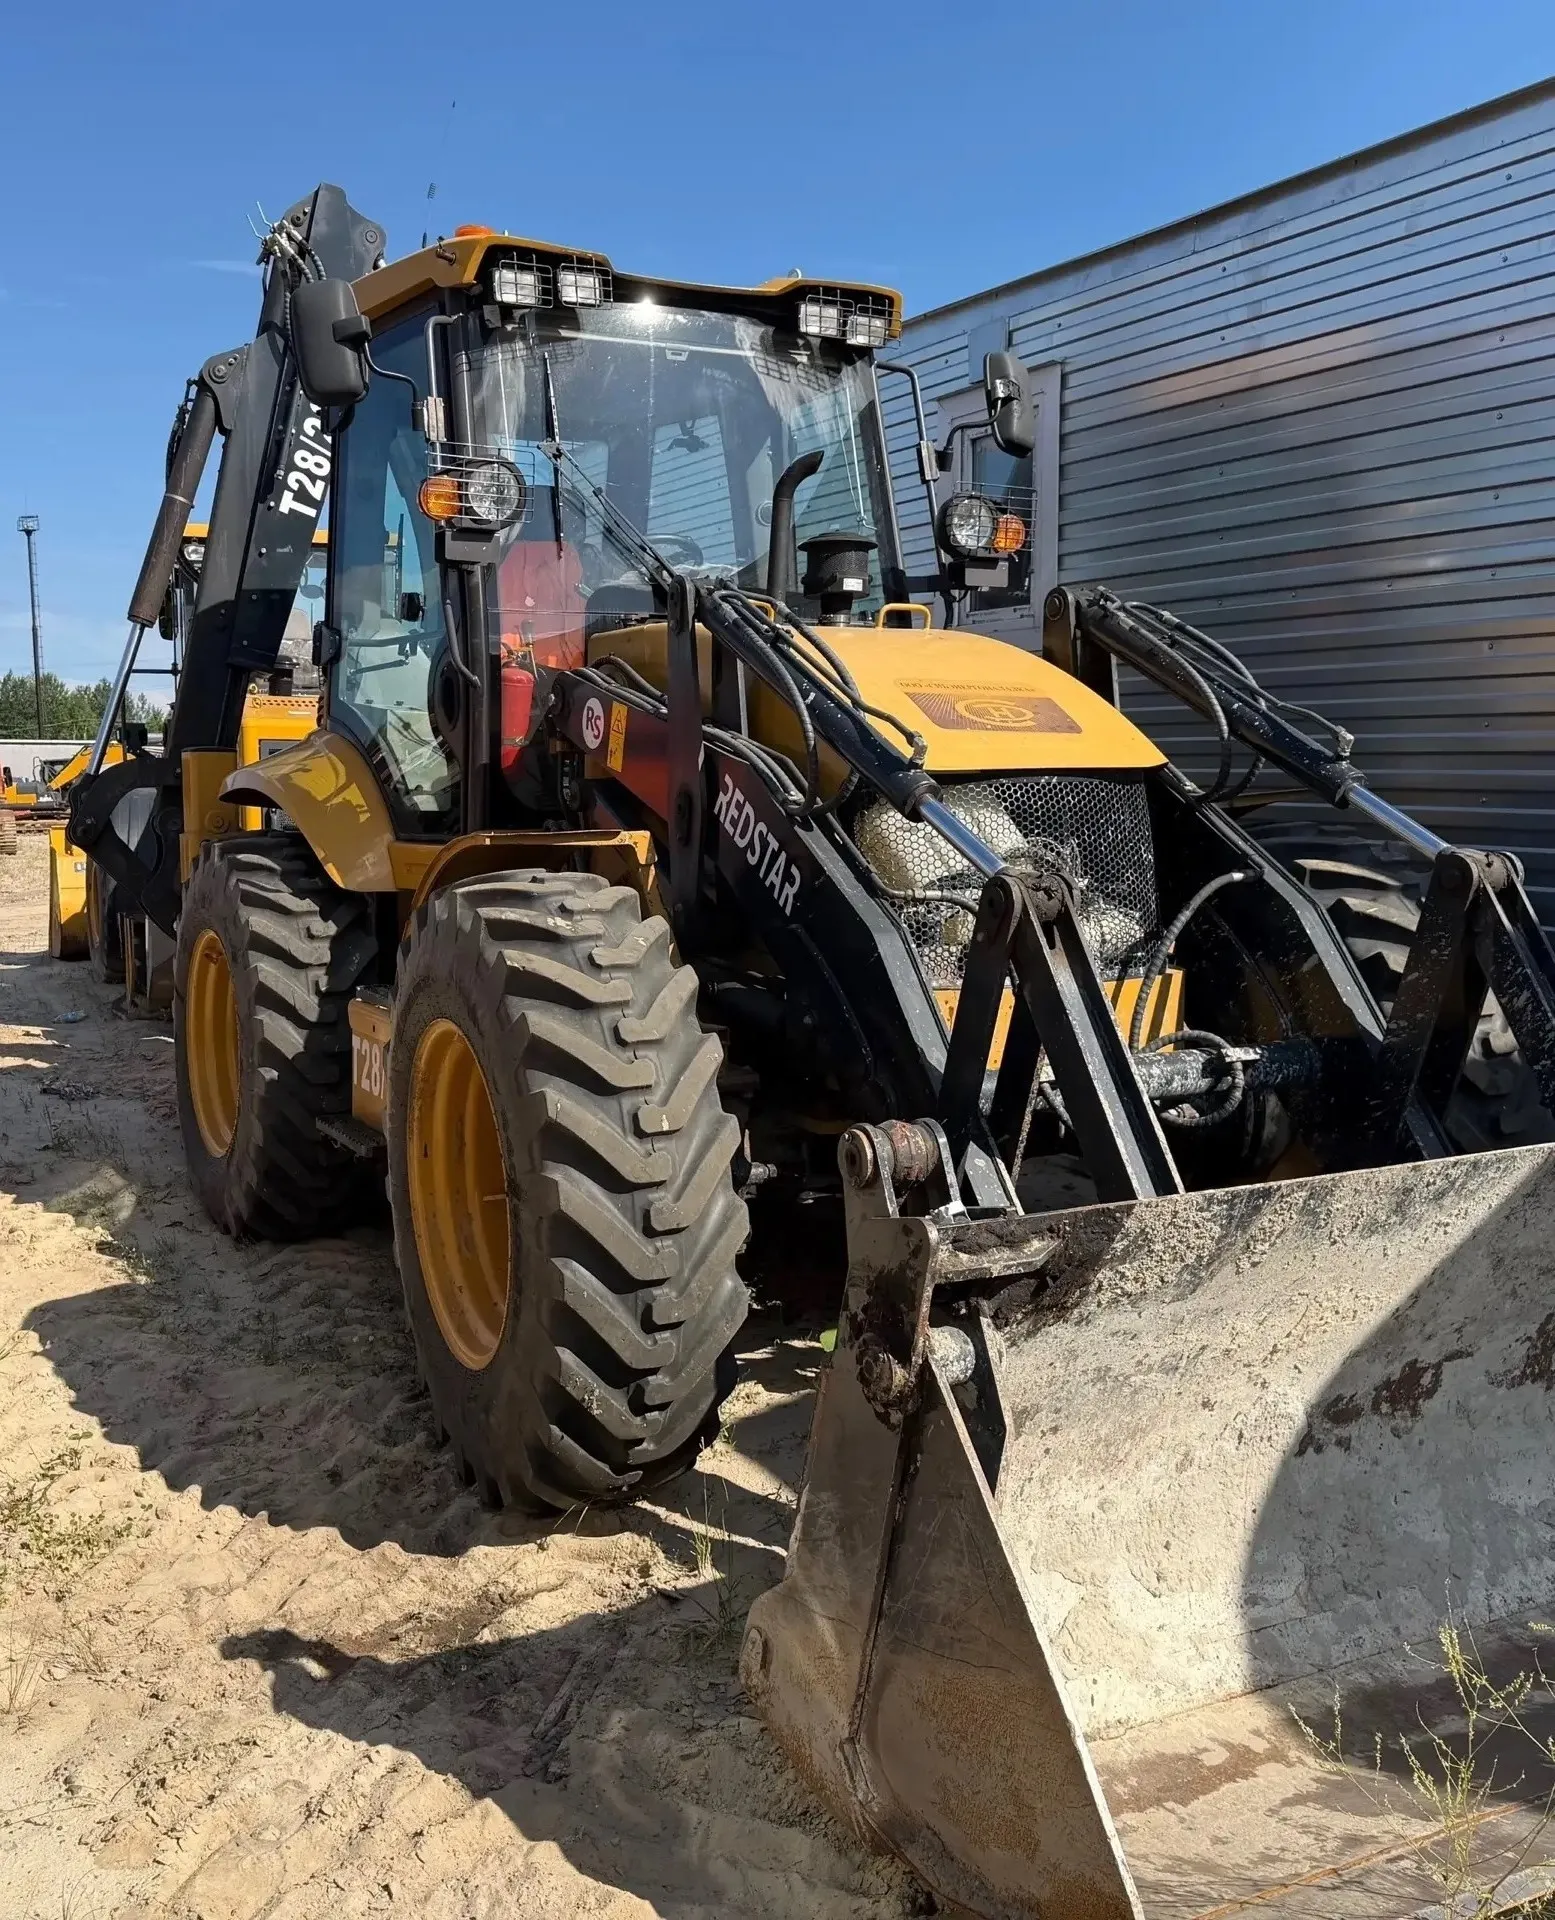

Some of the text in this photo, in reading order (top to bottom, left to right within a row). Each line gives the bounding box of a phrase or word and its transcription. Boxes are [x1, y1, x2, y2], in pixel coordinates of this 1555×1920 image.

[279, 402, 332, 518] T28/2
[586, 705, 602, 740] RS
[713, 773, 801, 917] REDSTAR
